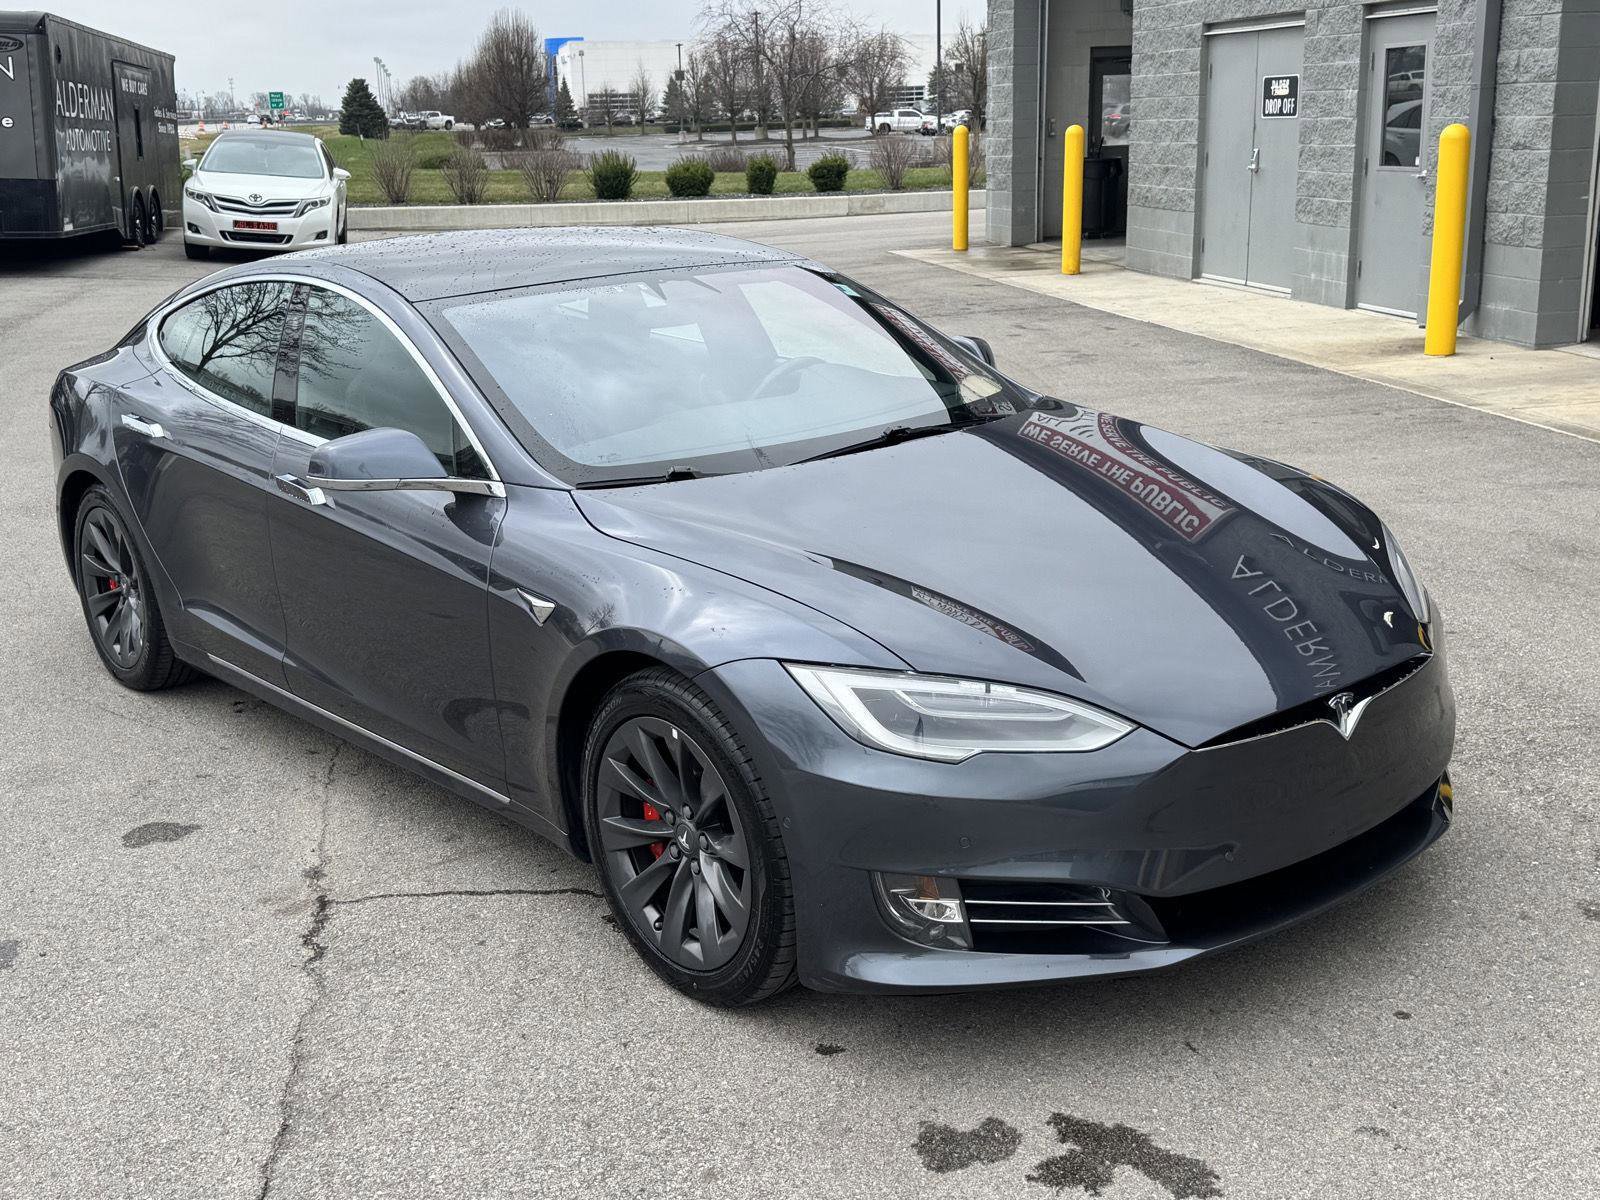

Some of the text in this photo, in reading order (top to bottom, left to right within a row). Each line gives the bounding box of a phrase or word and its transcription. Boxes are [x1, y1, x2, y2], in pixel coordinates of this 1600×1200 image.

[121, 77, 129, 93] WE
[137, 82, 148, 95] CARS
[56, 80, 114, 120] ALDERMAN
[1265, 98, 1295, 114] DROP OFF
[1, 117, 14, 128] e
[66, 128, 111, 151] AUTOMOTIVE
[1125, 449, 1160, 467] THE
[1155, 467, 1229, 508] PUBLIC
